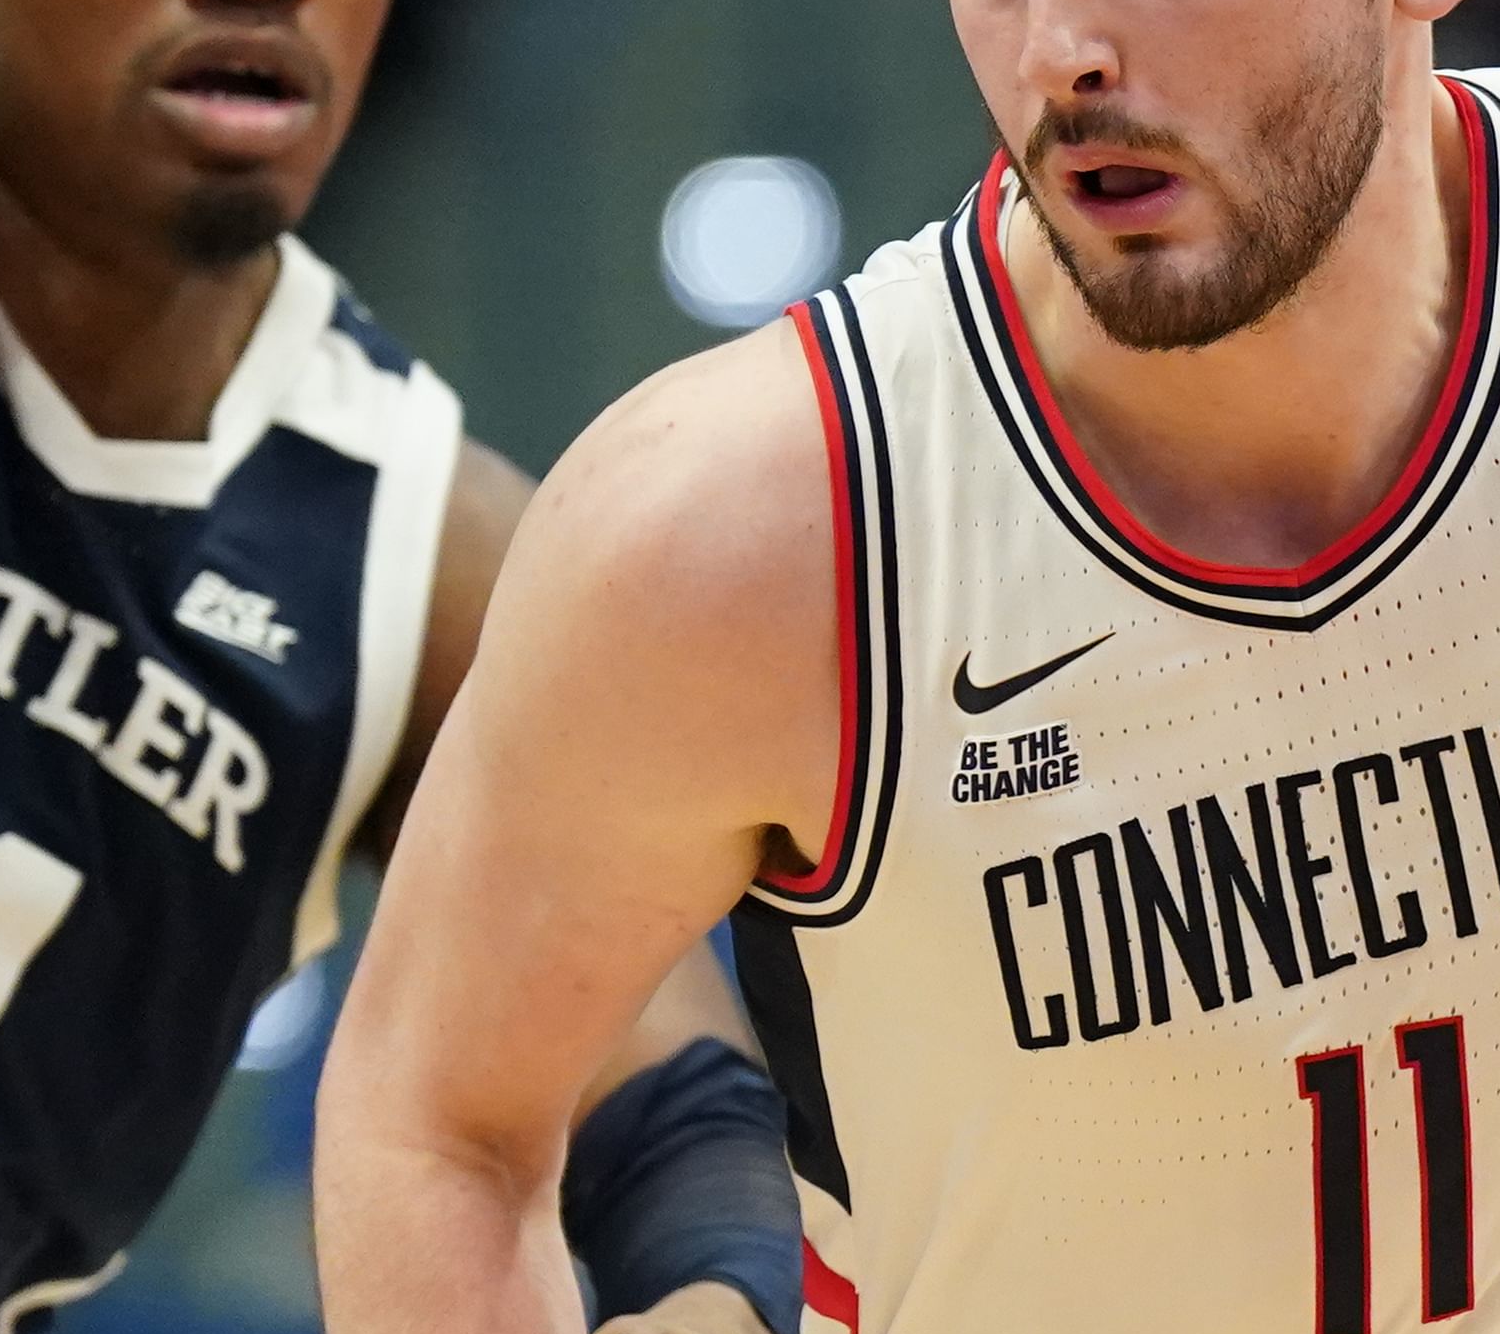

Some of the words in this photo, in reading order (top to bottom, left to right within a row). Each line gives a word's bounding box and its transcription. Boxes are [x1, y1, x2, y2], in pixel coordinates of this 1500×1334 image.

[960, 740, 998, 770] BE
[1008, 723, 1070, 765] THE
[951, 753, 1080, 803] CHANGE
